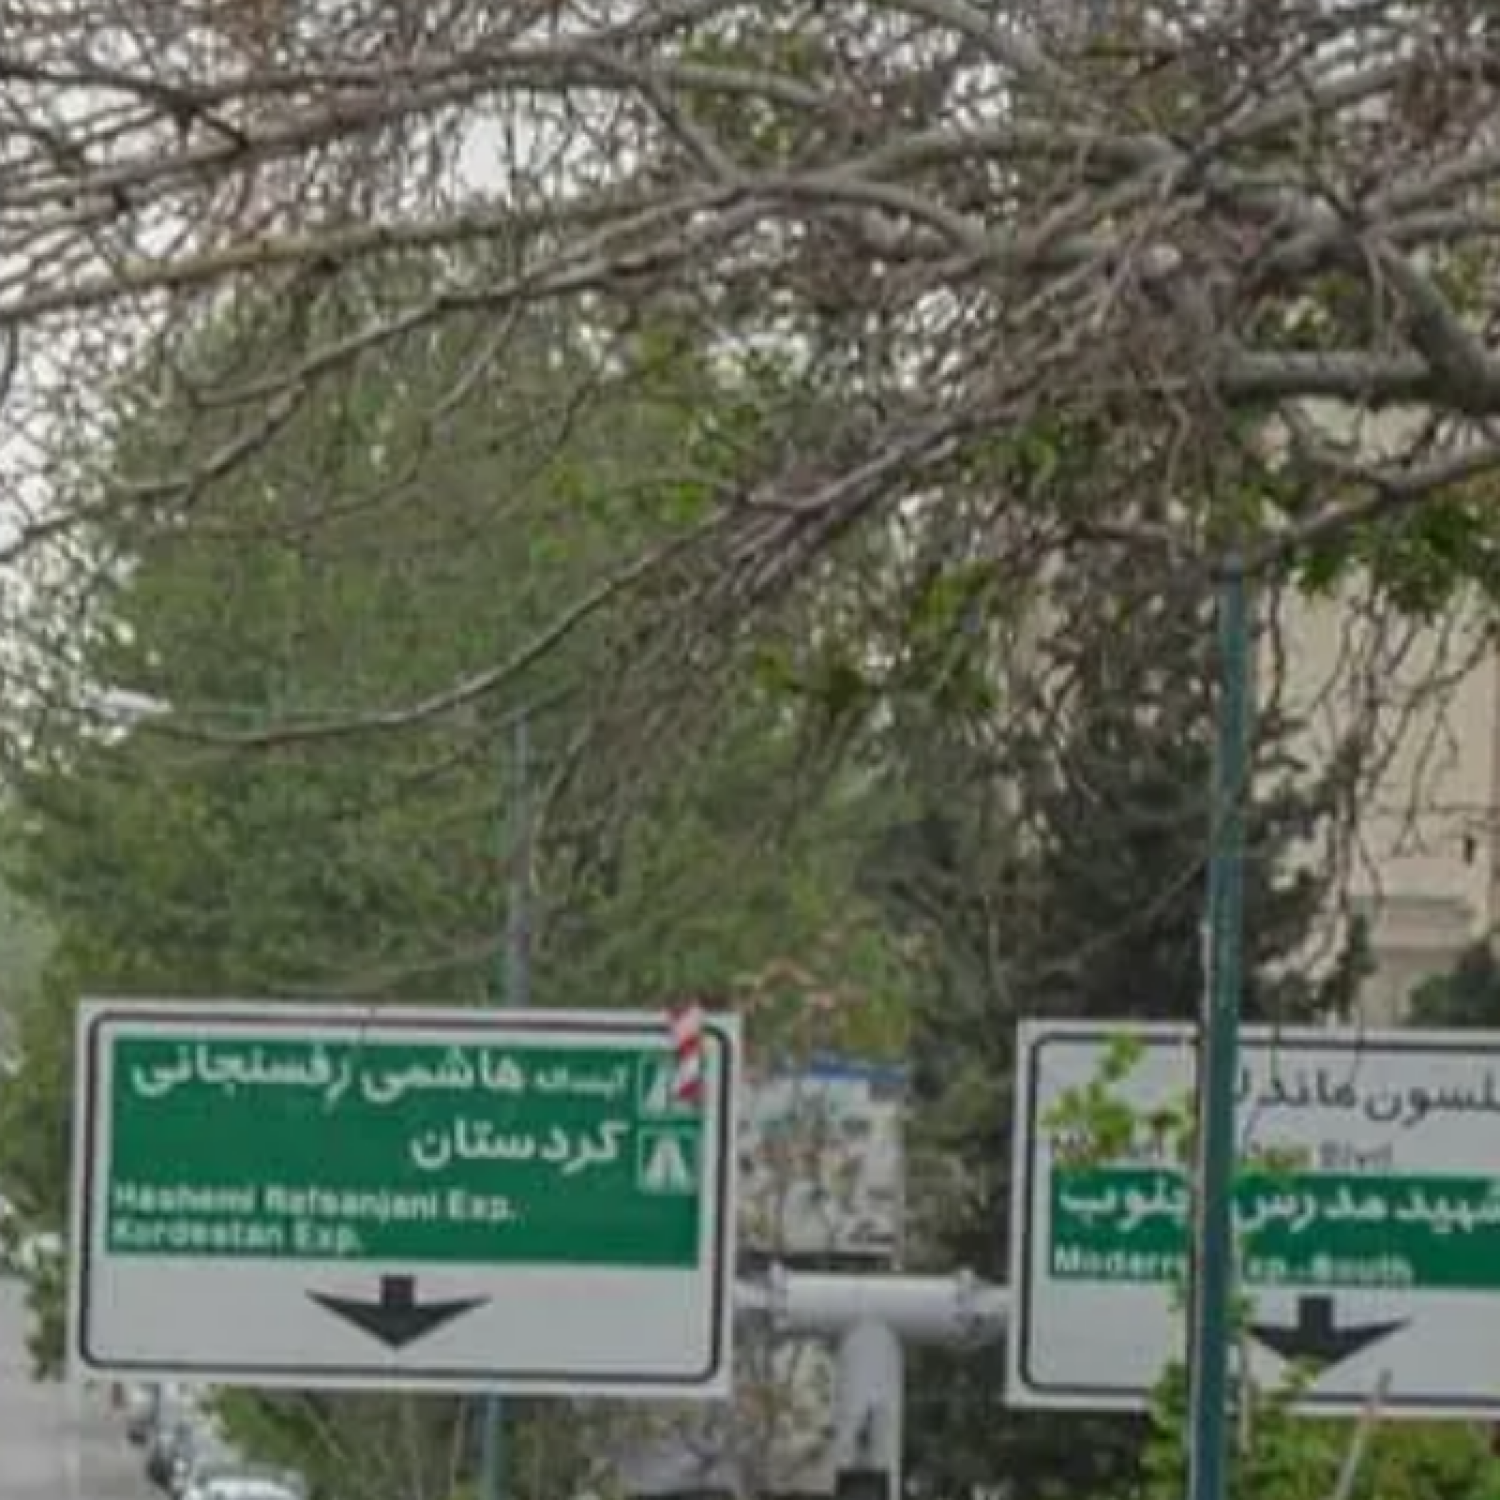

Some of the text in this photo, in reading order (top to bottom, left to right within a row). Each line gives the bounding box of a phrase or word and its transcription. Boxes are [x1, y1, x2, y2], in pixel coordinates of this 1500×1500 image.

[131, 1046, 351, 1113] رفسنجانی
[361, 1046, 524, 1102] هاشمی
[1364, 1069, 1500, 1128] لسون
[410, 1116, 631, 1174] کردستان
